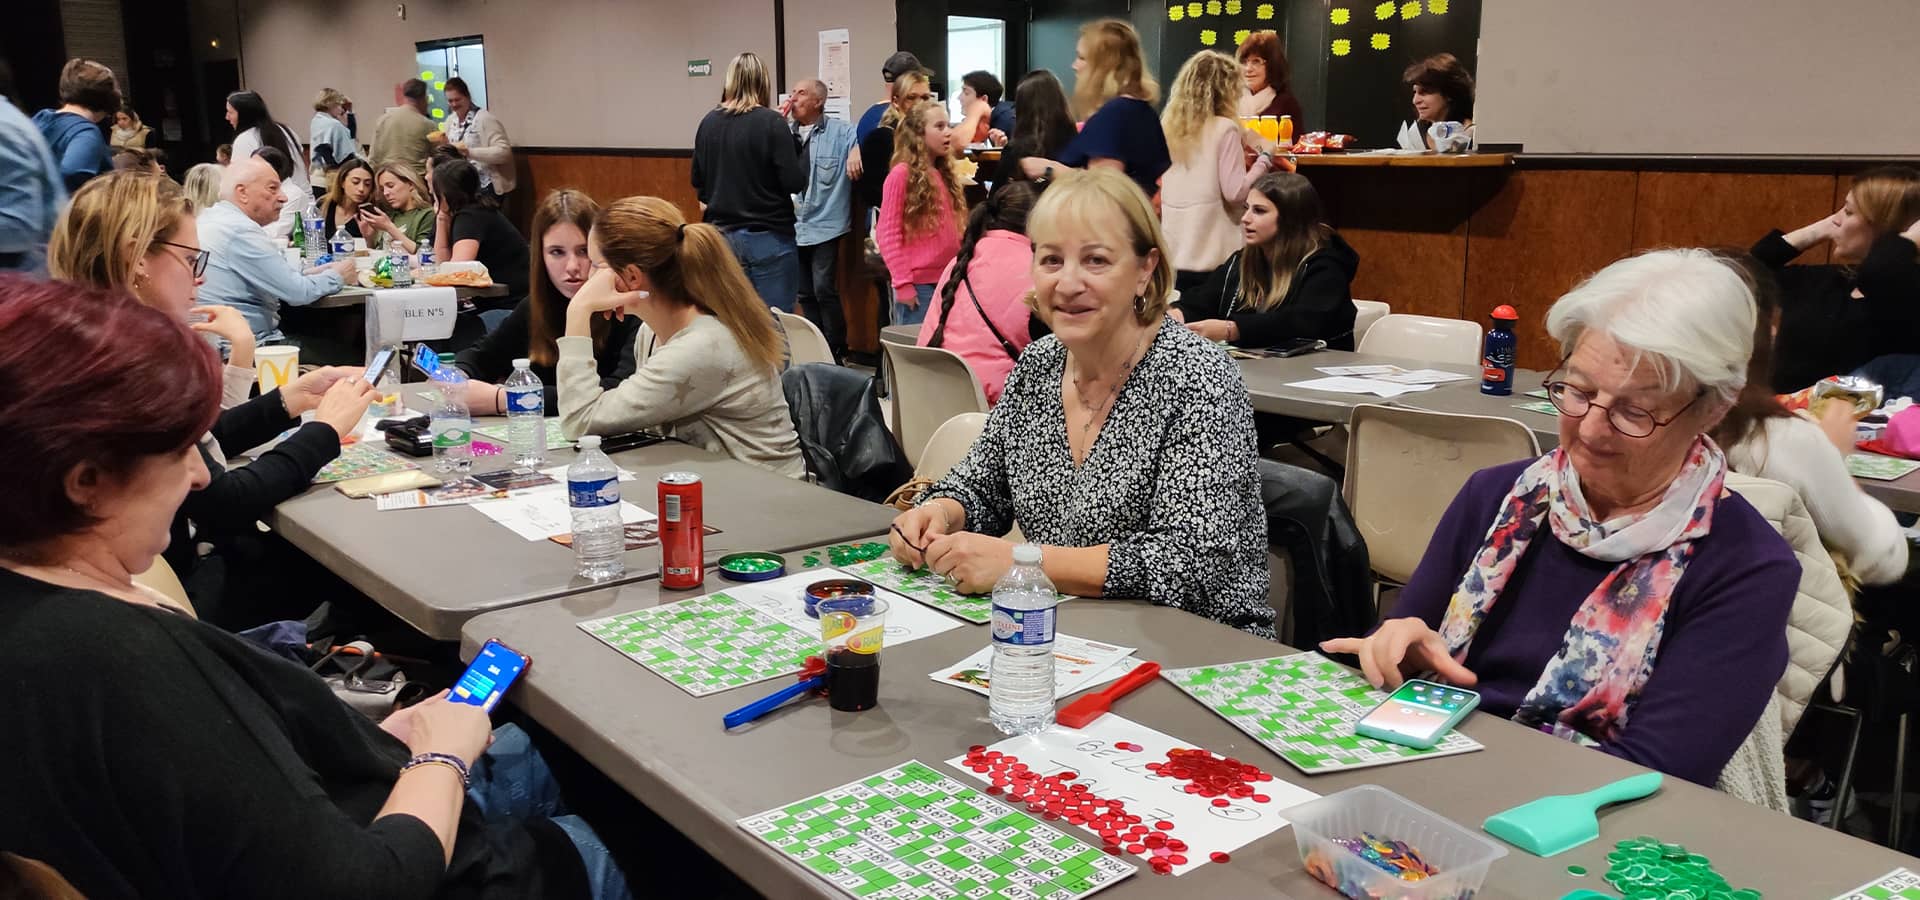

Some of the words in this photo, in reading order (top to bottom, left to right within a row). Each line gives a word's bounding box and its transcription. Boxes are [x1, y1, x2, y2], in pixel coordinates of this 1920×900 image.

[404, 309, 424, 318] BLE
[909, 818, 927, 826] 67
[918, 804, 936, 812] 55
[929, 810, 947, 818] 69
[941, 816, 959, 824] 72
[870, 833, 888, 841] 65
[1029, 826, 1048, 834] 27
[1041, 832, 1060, 840] 35
[1067, 844, 1086, 853] 59
[1094, 857, 1114, 867] 79
[1107, 864, 1127, 873] 84
[826, 849, 845, 858] 64
[980, 835, 998, 844] 14
[992, 842, 1011, 850] 28
[1016, 854, 1036, 863] 45
[1043, 868, 1062, 877] 66
[999, 828, 1018, 836] 13
[1023, 840, 1042, 849] 39
[1036, 846, 1055, 855] 40
[1048, 852, 1068, 862] 52
[1089, 873, 1109, 882] 86
[897, 869, 916, 878] 19
[920, 882, 939, 892] 34
[932, 889, 952, 899] 46
[919, 860, 939, 869] 15
[930, 866, 950, 876] 25
[942, 873, 962, 882] 30
[968, 887, 988, 897] 53
[959, 844, 978, 853] 18
[971, 850, 990, 859] 26
[1008, 870, 1027, 879] 57
[1022, 877, 1041, 887] 68
[1048, 891, 1068, 900] 80
[963, 865, 982, 874] 33
[975, 871, 995, 881] 42
[1002, 886, 1021, 896] 60
[885, 884, 905, 894] 21
